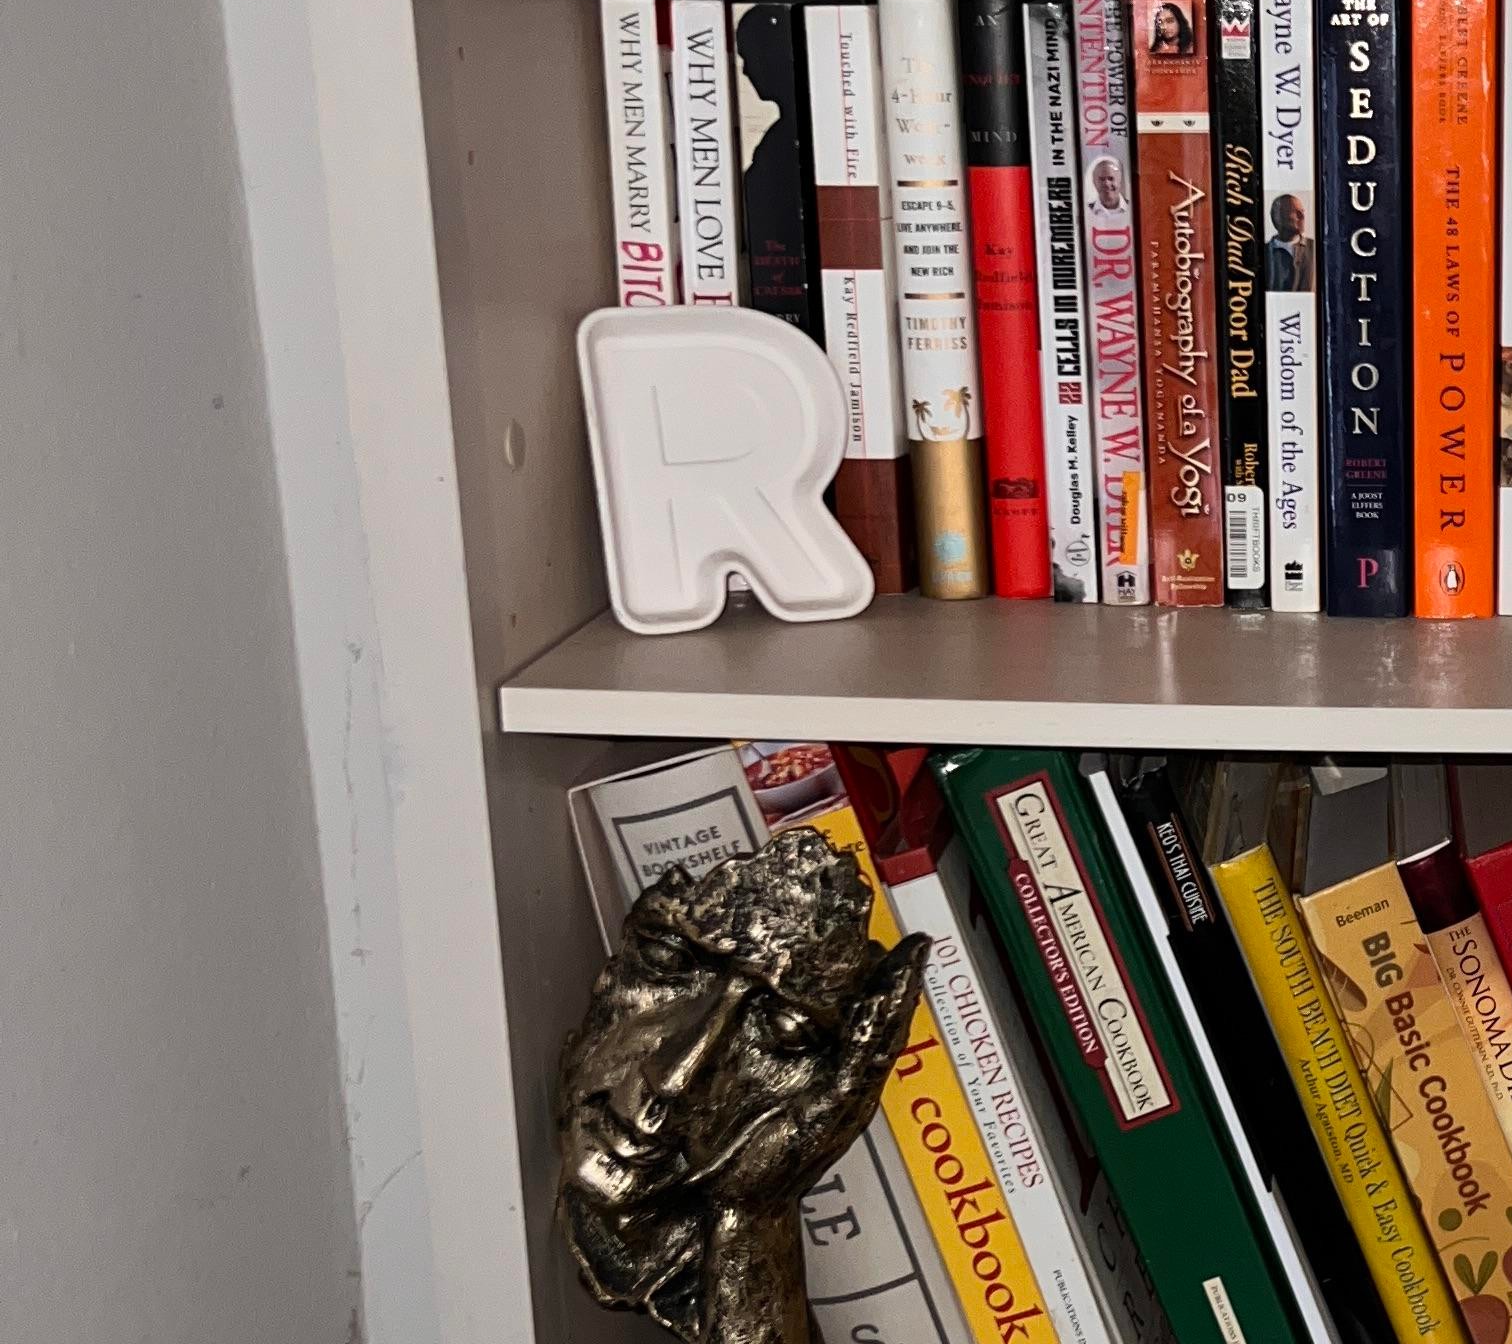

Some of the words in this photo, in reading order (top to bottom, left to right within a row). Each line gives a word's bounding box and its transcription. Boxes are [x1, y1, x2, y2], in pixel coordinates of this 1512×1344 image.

[618, 11, 643, 74] WHY
[1331, 14, 1361, 27] ART
[1367, 13, 1389, 27] OF
[686, 28, 717, 107] WHY
[1272, 63, 1301, 95] W.
[622, 81, 646, 137] MEN
[1274, 103, 1301, 171] Dyer
[690, 117, 721, 188] MEN
[626, 145, 651, 233] MARRY
[695, 199, 725, 281] LOVE
[1347, 41, 1379, 436] SEDUCTION
[1163, 170, 1207, 386] Autobiography
[1278, 311, 1301, 398] Wisdom
[1181, 422, 1198, 436] a
[1182, 394, 1203, 416] of
[1278, 406, 1301, 429] of
[1279, 438, 1300, 473] the
[1437, 353, 1467, 532] POWER
[1167, 440, 1211, 517] Yogi
[1277, 478, 1300, 532] Ages
[643, 825, 721, 856] VINTAGE
[1334, 897, 1391, 929] Beeman
[1013, 791, 1057, 871] GREAT
[1043, 880, 1107, 992] AMERICAN
[1098, 997, 1155, 1112] COOKBOOK
[934, 935, 958, 968] 101
[948, 973, 1008, 1086] CHICKEN
[991, 1089, 1044, 1189] RECIPES
[1360, 930, 1405, 991] BIG
[1384, 990, 1432, 1073] Basic
[1418, 1075, 1489, 1218] Cookbook
